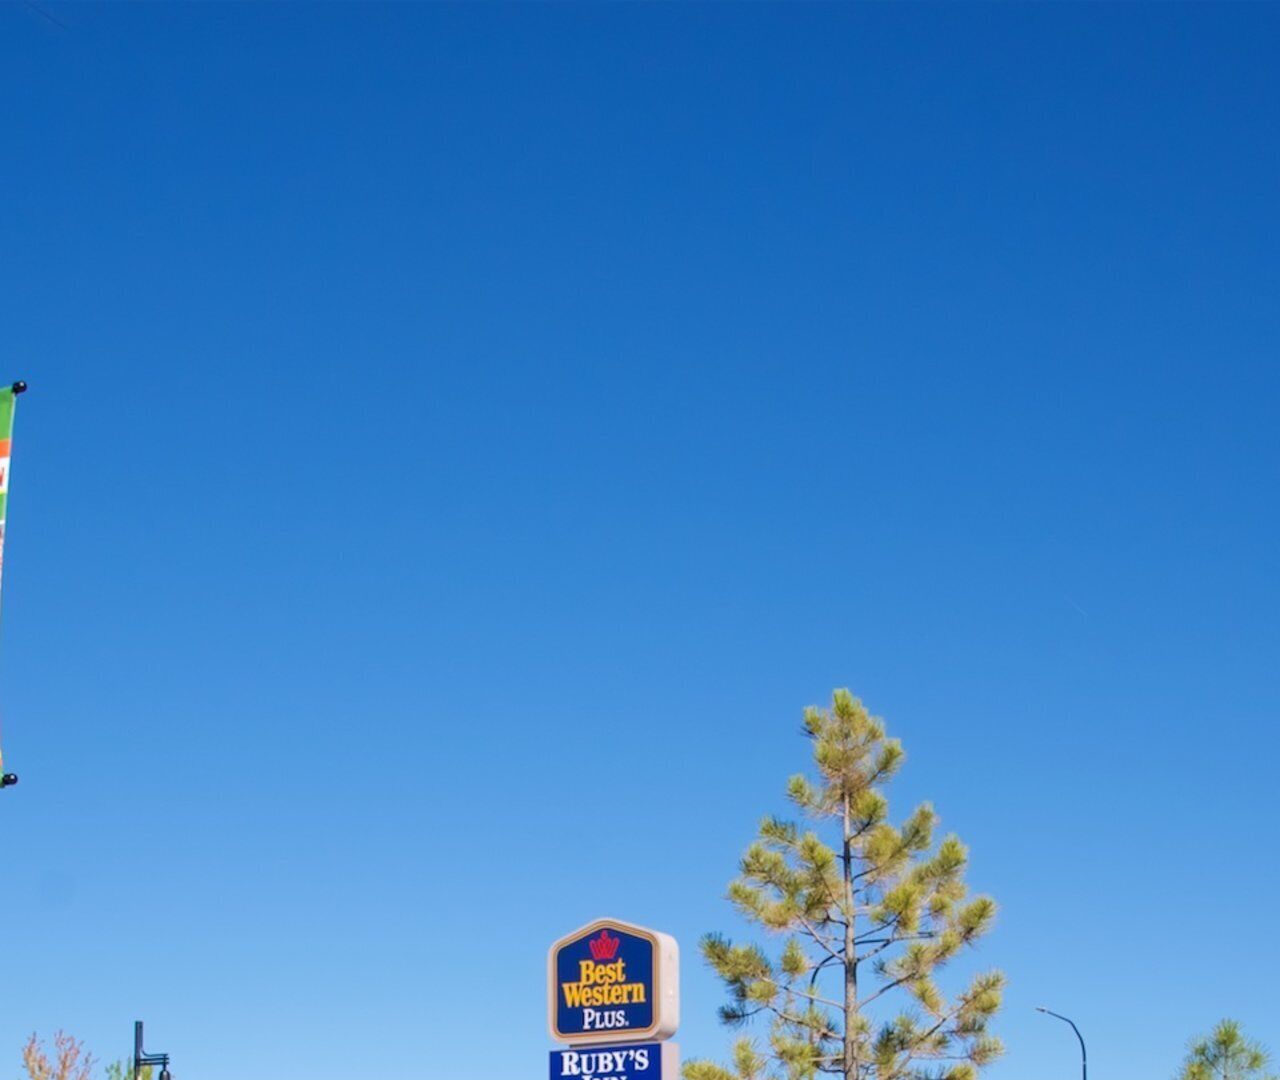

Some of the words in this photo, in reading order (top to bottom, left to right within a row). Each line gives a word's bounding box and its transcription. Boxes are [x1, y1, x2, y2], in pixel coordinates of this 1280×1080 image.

[579, 957, 626, 986] Best
[562, 982, 646, 1008] Western
[561, 1049, 650, 1076] RUBY'S
